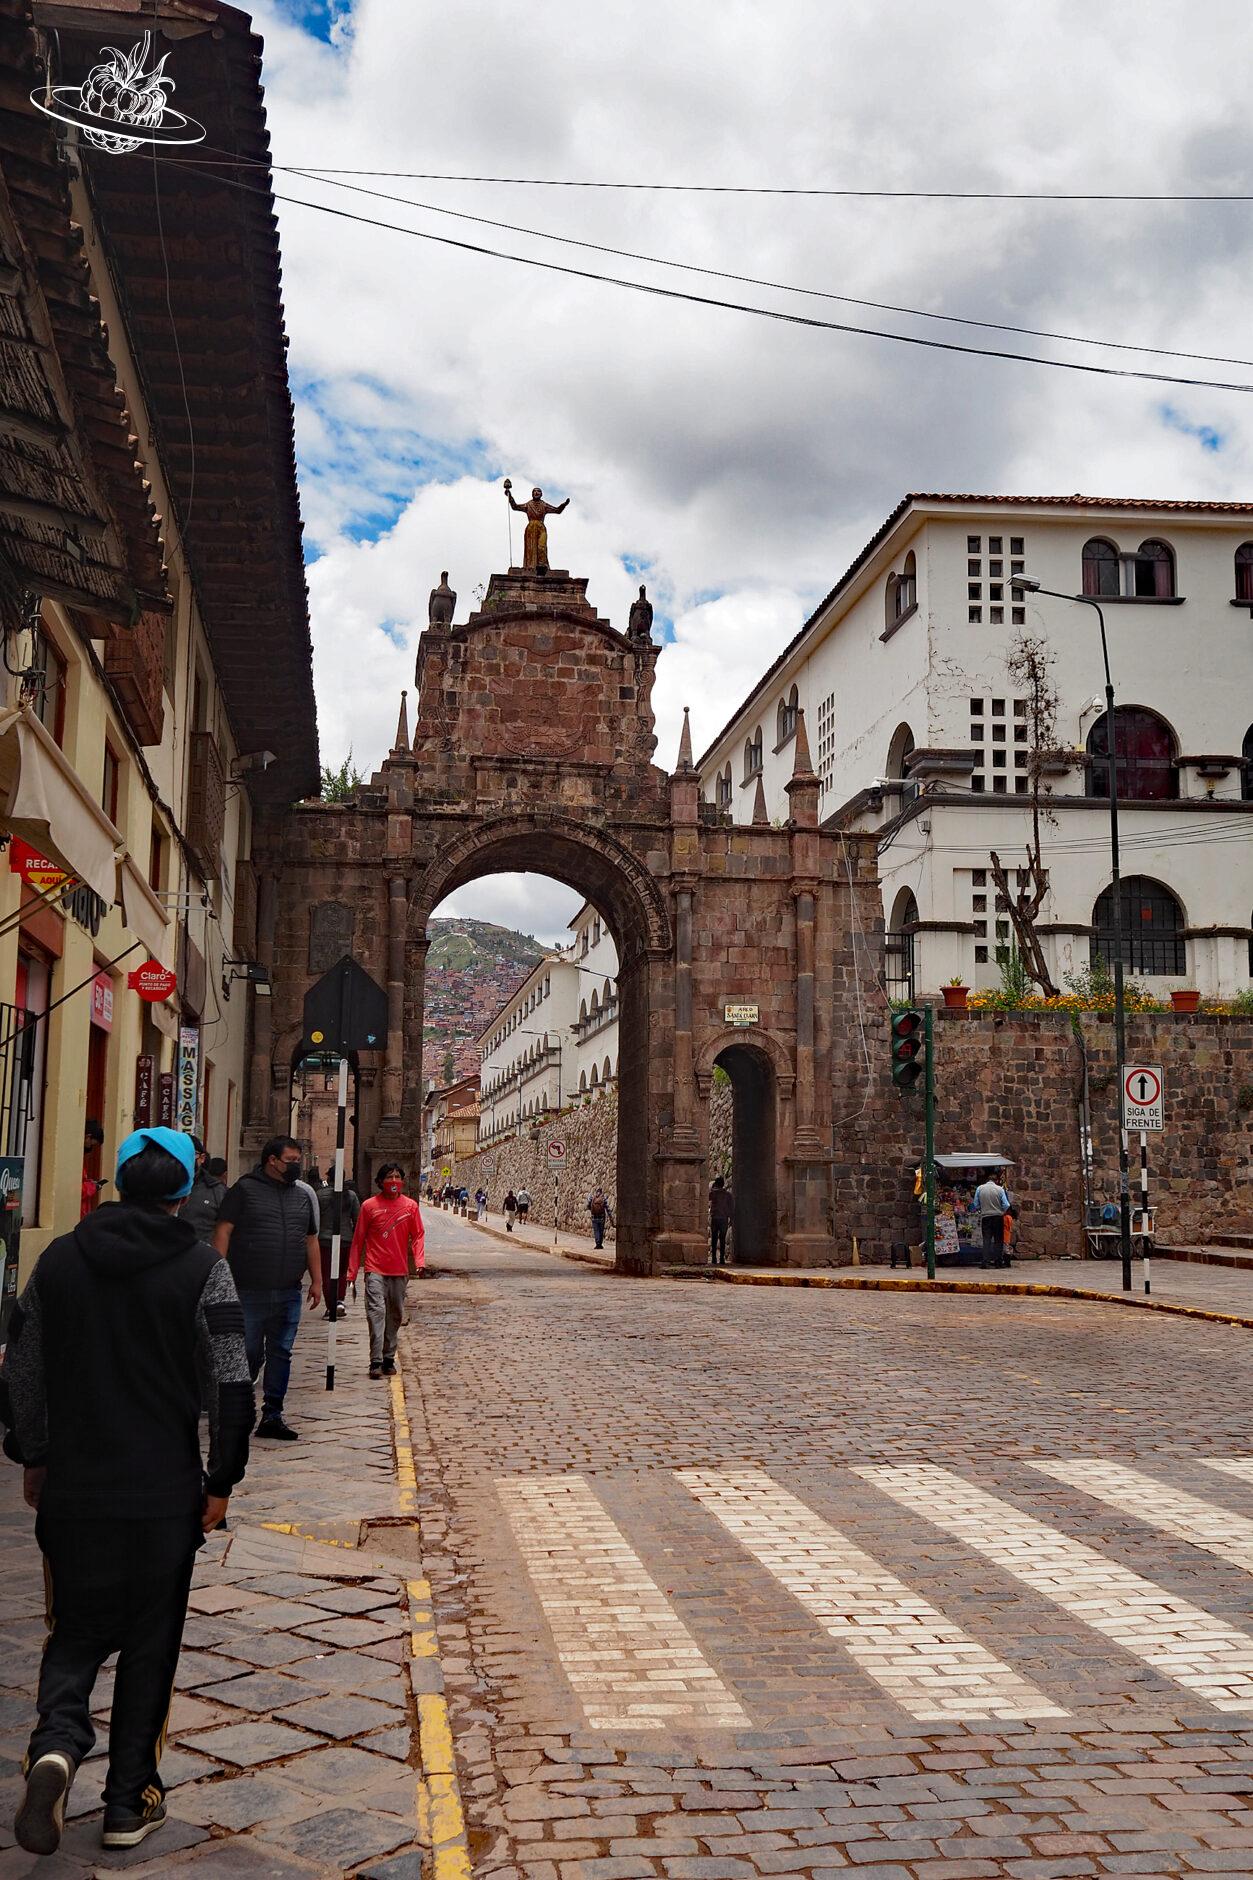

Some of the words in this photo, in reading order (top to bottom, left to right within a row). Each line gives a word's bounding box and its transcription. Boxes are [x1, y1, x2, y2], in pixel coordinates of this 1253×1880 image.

[26, 859, 58, 869] RECA
[140, 969, 166, 980] Claro
[1127, 1107, 1146, 1117] SIGA
[1149, 1108, 1160, 1117] DE
[1126, 1118, 1161, 1128] FRENTE
